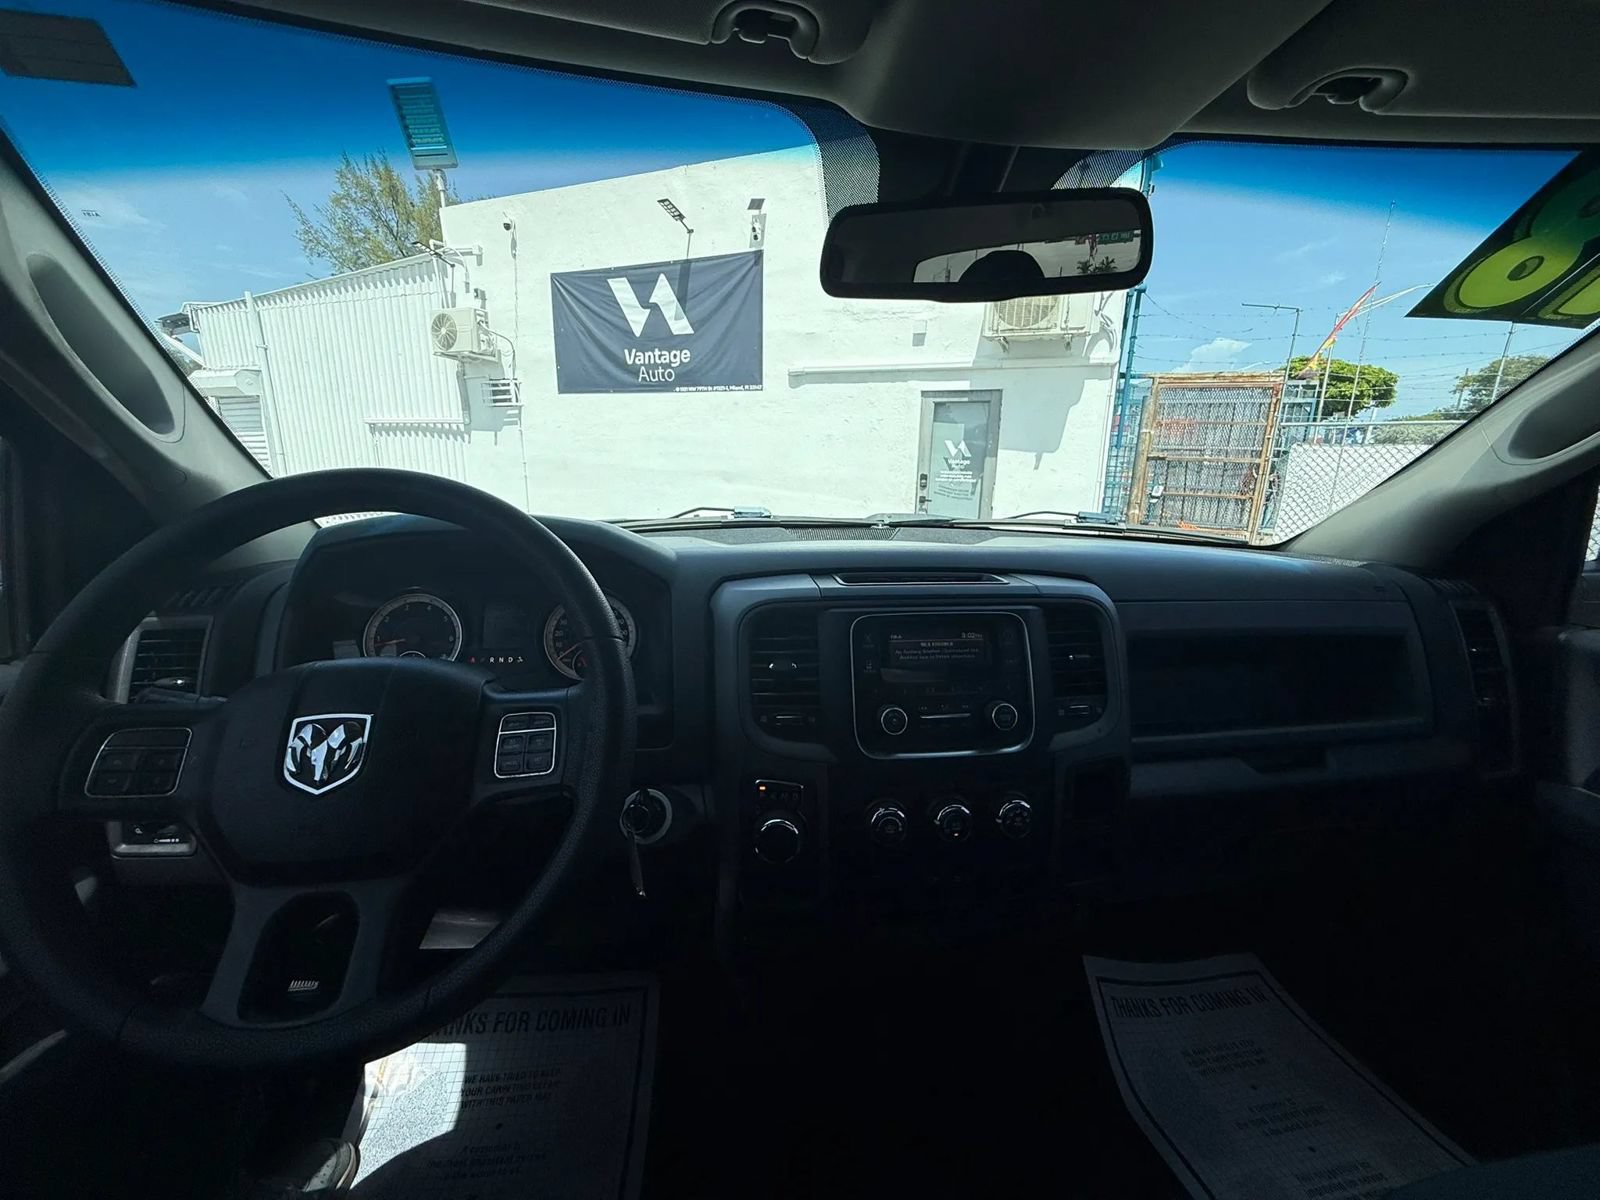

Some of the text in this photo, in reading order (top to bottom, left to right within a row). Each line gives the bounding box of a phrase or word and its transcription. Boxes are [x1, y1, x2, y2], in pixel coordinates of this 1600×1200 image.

[624, 348, 691, 367] Vantage
[638, 366, 675, 382] Auto
[1111, 985, 1270, 1019] THANKS FOR COMING IN
[494, 1011, 530, 1034] FOR
[535, 1006, 608, 1031] COMING
[612, 1003, 631, 1027] IN
